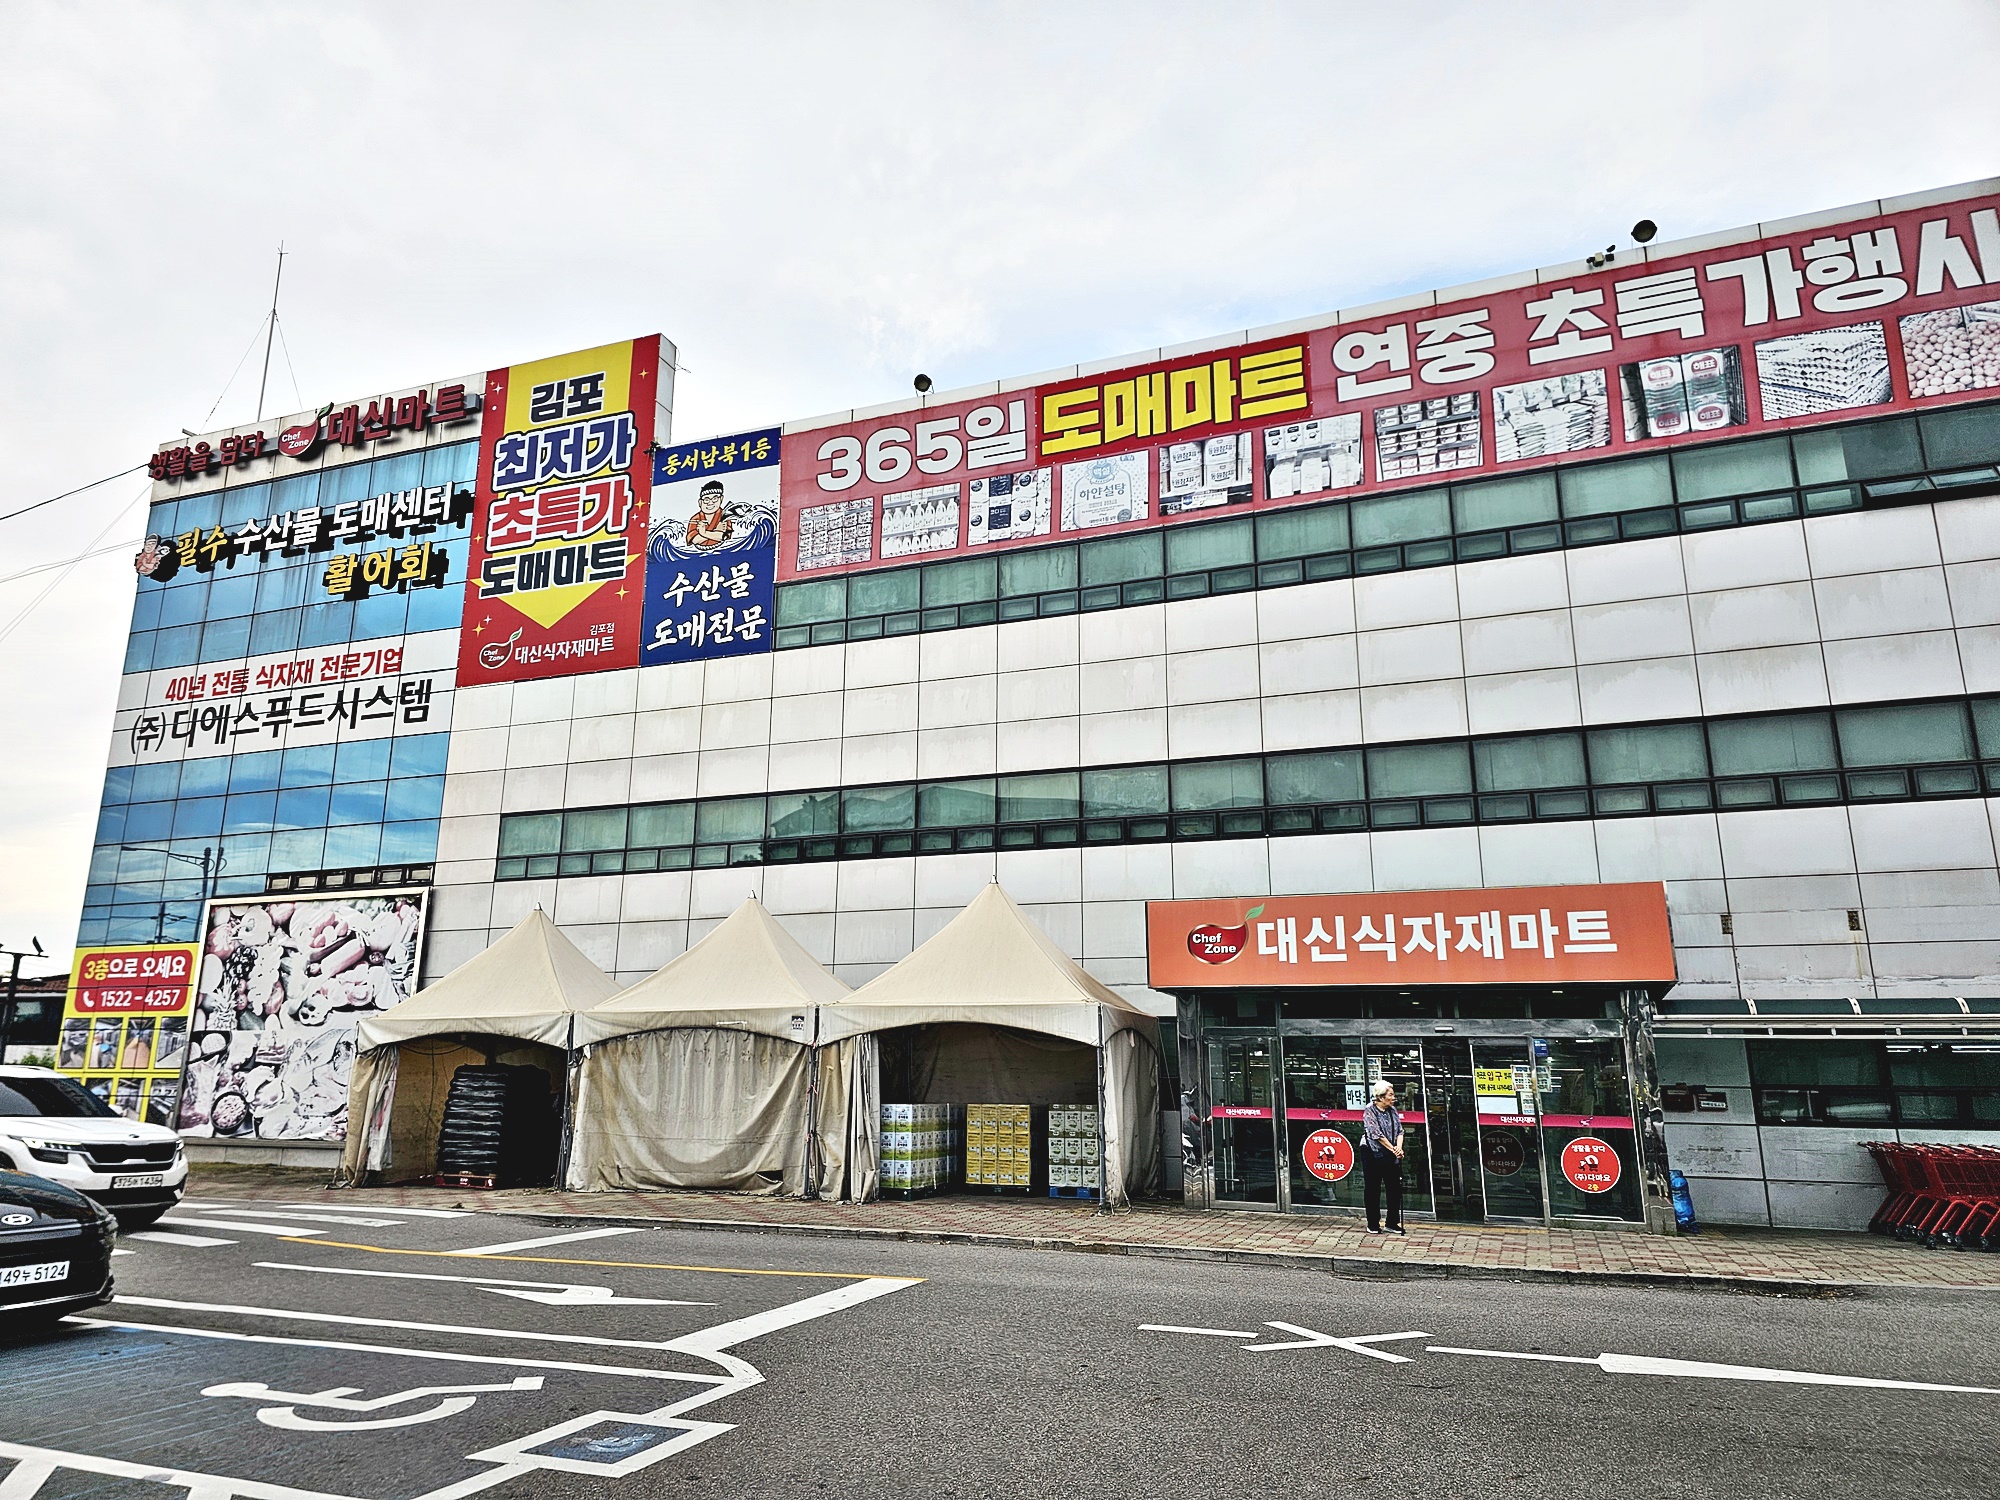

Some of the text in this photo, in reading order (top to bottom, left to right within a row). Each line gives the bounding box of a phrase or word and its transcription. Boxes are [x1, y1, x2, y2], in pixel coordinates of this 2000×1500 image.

[1332, 207, 2000, 403] 연중 초특가행사
[327, 384, 467, 445] 대신마트
[531, 372, 606, 424] 김포
[1041, 345, 1308, 457] 도매마트
[149, 430, 267, 481] 생활을 담다
[282, 431, 302, 442] Chef
[288, 439, 310, 449] Zone
[496, 416, 633, 488] 최저가
[662, 436, 771, 476] 동서남북1등
[816, 400, 1027, 491] 365일
[489, 478, 630, 549] 초특가
[1079, 483, 1126, 500] 하얀설탕
[176, 481, 455, 566] 필수 수산물 도매센터
[326, 541, 432, 595] 활어회
[480, 538, 627, 598] 도매마트
[662, 561, 755, 607] 수산물
[514, 635, 615, 664] 대신식자재마트
[590, 622, 615, 636] 김포점
[646, 604, 768, 652] 도매전문
[165, 647, 403, 701] 40년 전통 식자재 전문기업
[488, 654, 505, 662] Zone
[1192, 933, 1222, 944] Chef
[1204, 943, 1237, 954] Zone
[1257, 907, 1618, 964] 대신식자재마트
[84, 955, 186, 980] 3층으로 오세요
[34, 1264, 66, 1280] 5124
